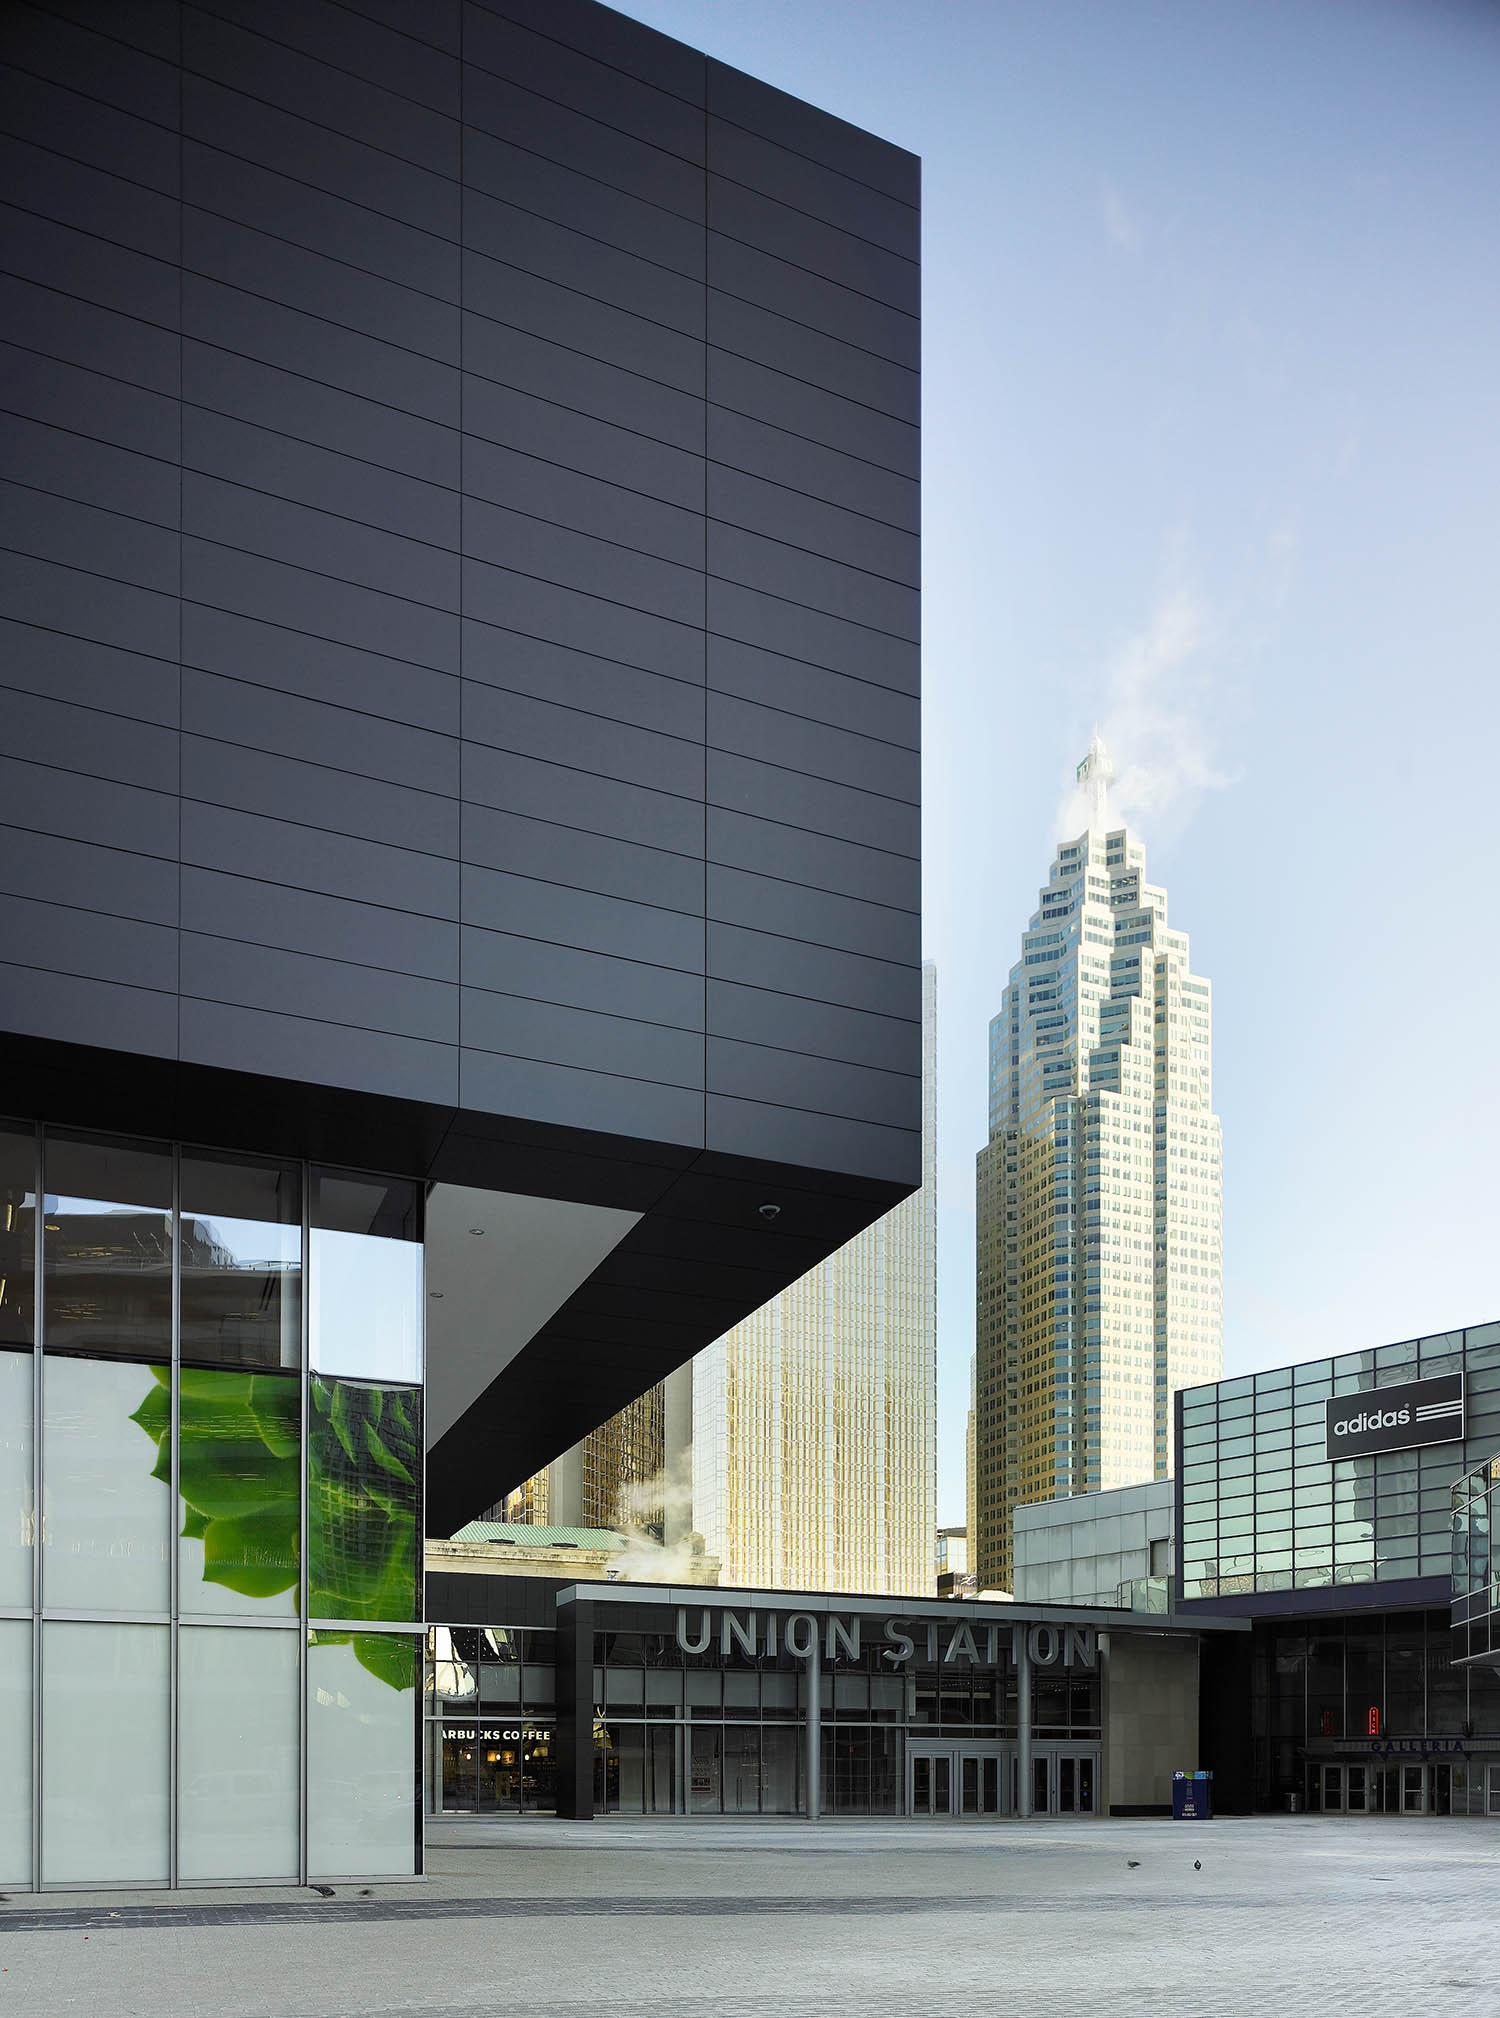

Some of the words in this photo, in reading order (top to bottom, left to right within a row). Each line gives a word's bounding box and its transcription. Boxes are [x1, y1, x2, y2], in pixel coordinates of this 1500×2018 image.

[1334, 1410, 1411, 1436] adidas
[676, 1607, 861, 1660] UNION
[882, 1617, 1097, 1668] STATION
[502, 1731, 551, 1740] COFFEE
[1371, 1741, 1464, 1752] GALLERIA
